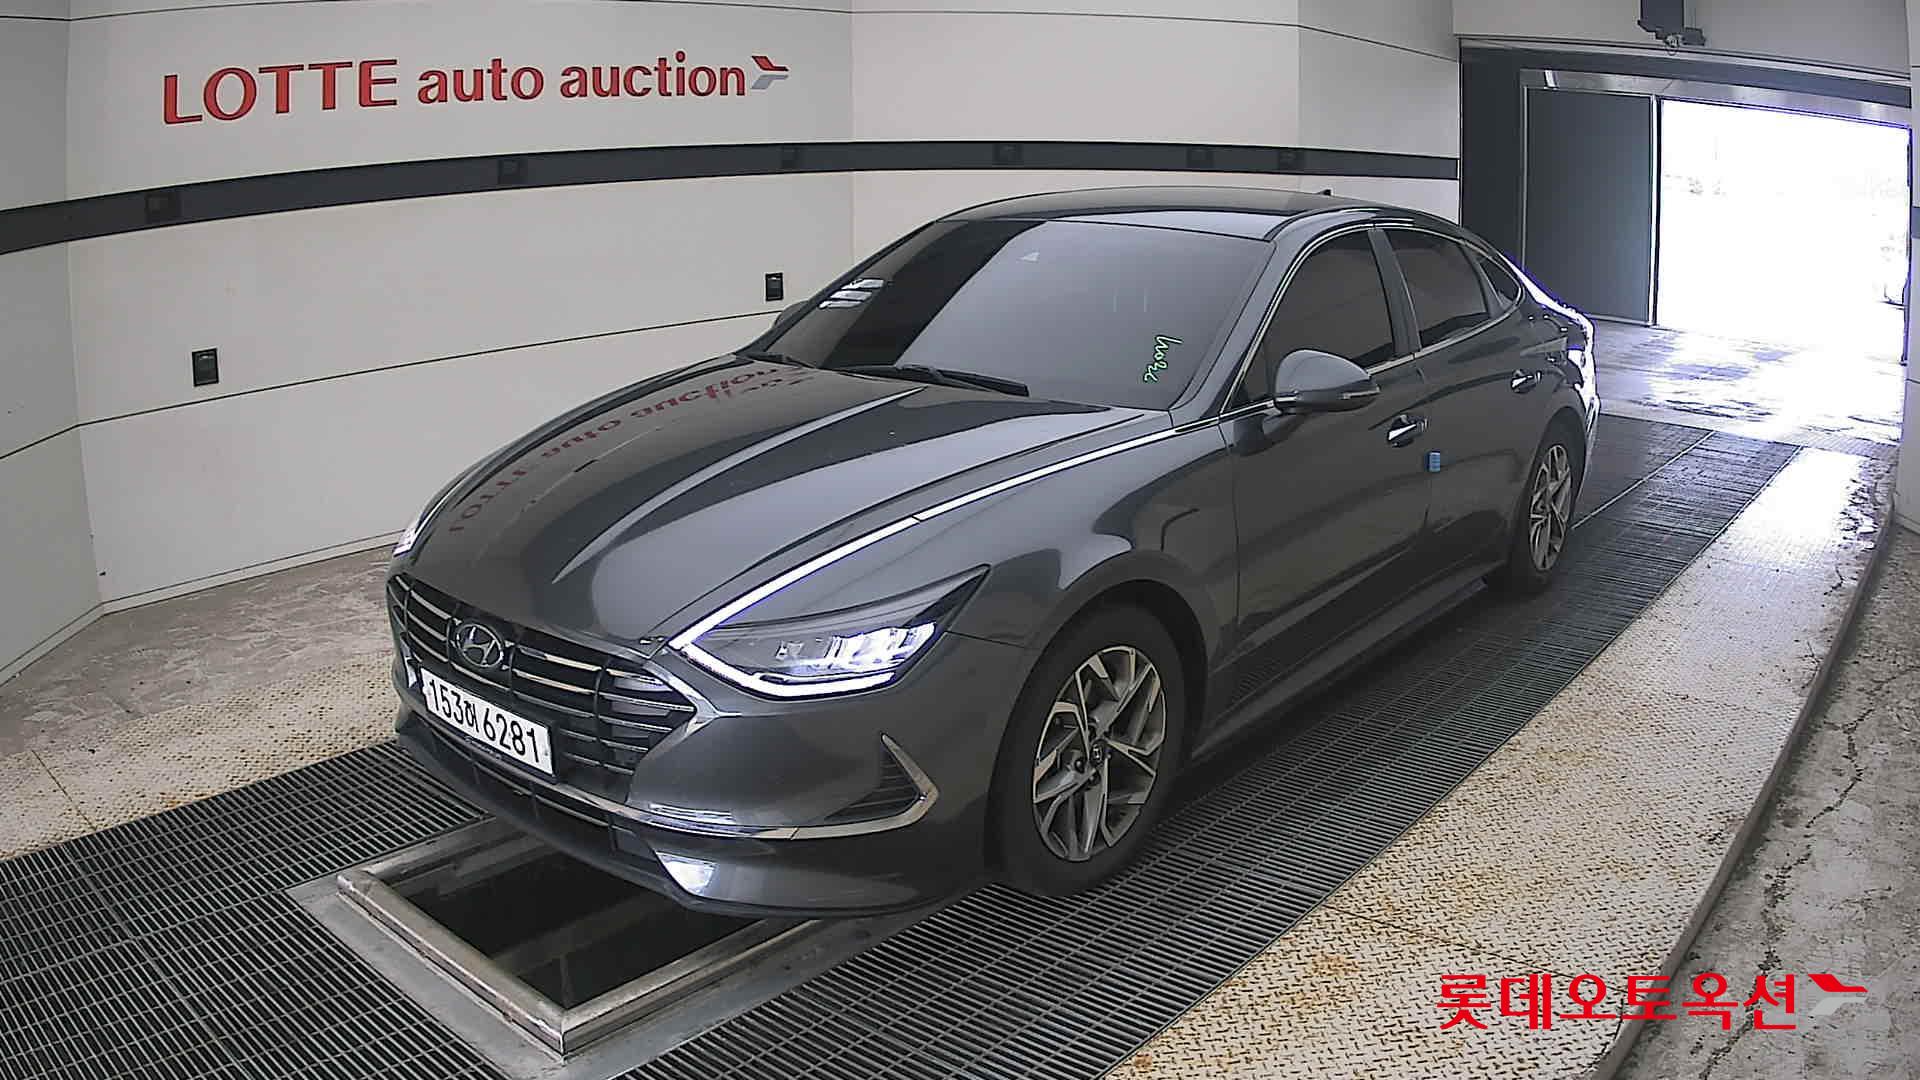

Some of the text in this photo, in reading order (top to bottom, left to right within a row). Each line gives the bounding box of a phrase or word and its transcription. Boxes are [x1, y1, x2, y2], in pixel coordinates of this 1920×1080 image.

[164, 51, 746, 124] LOTTE auto auction
[483, 707, 540, 763] 6281
